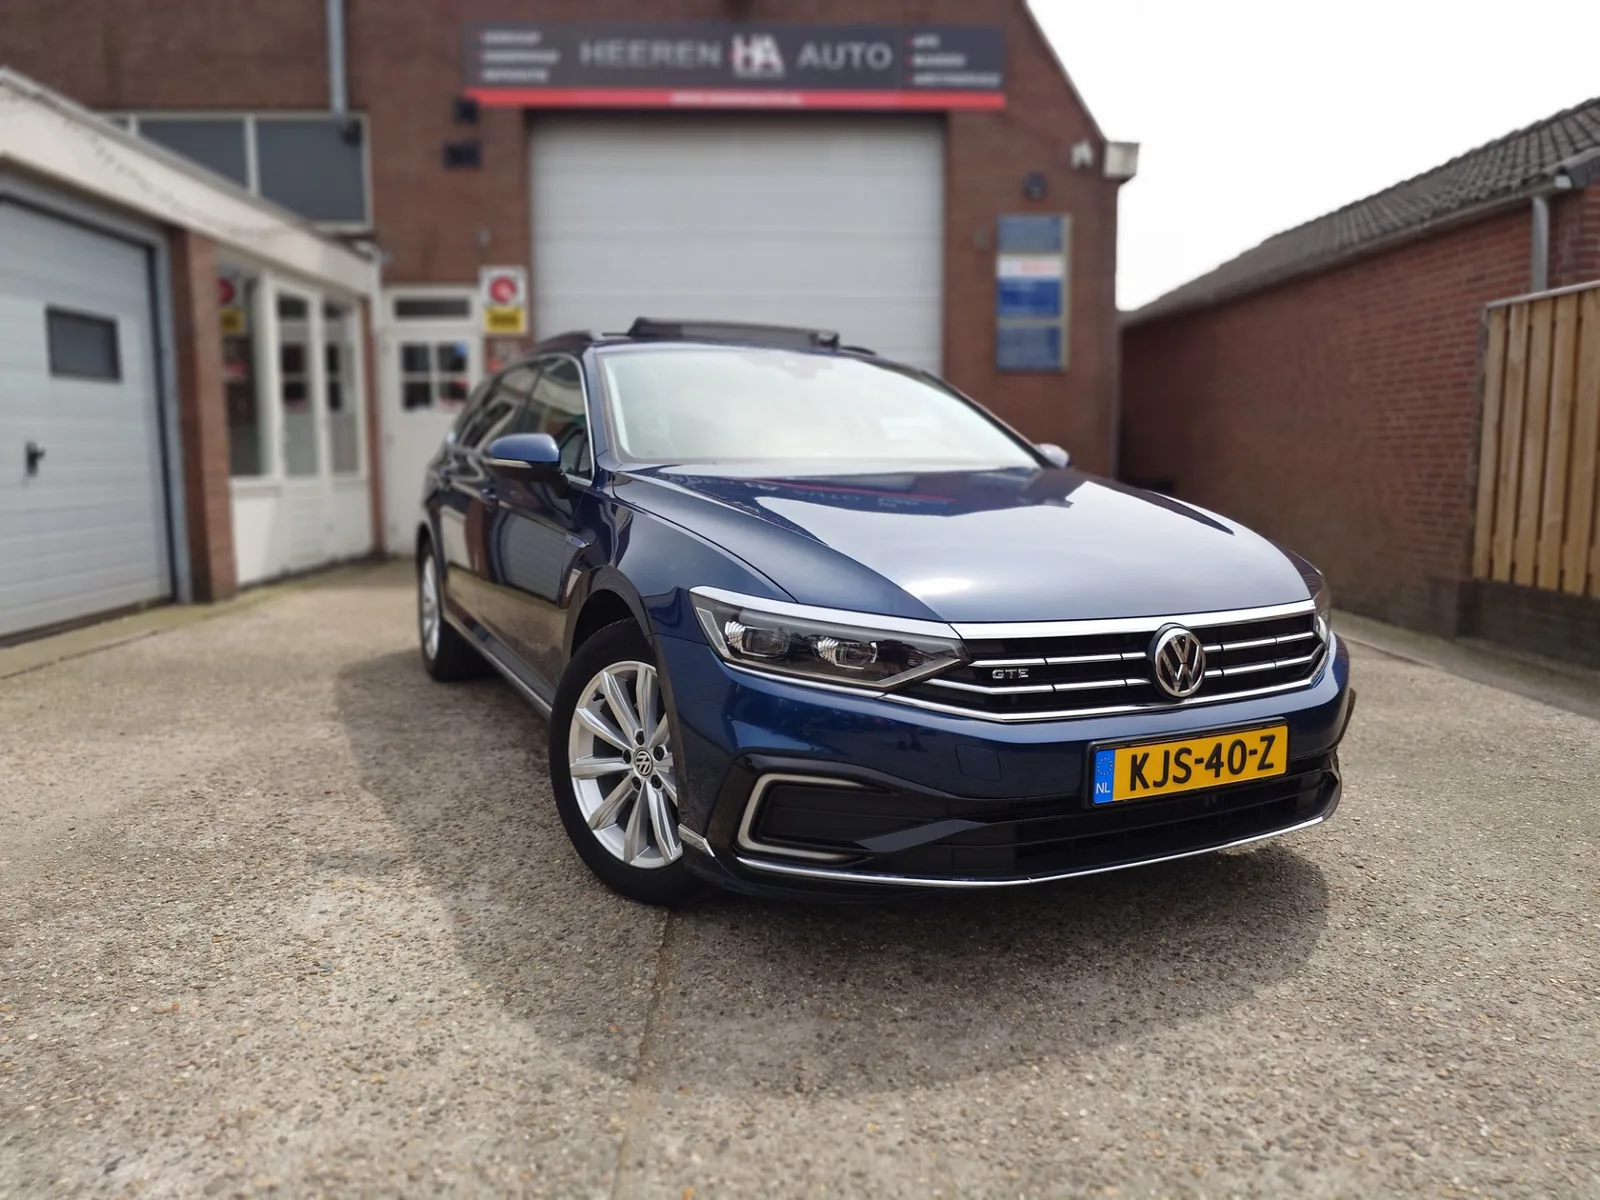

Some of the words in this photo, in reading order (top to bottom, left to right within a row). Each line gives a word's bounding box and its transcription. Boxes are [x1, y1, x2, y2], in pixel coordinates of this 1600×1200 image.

[579, 40, 722, 69] HEEREN
[797, 41, 893, 71] AUTO
[992, 668, 1029, 679] GTE
[1129, 734, 1276, 791] KJS-40-Z
[1096, 782, 1111, 795] NL
